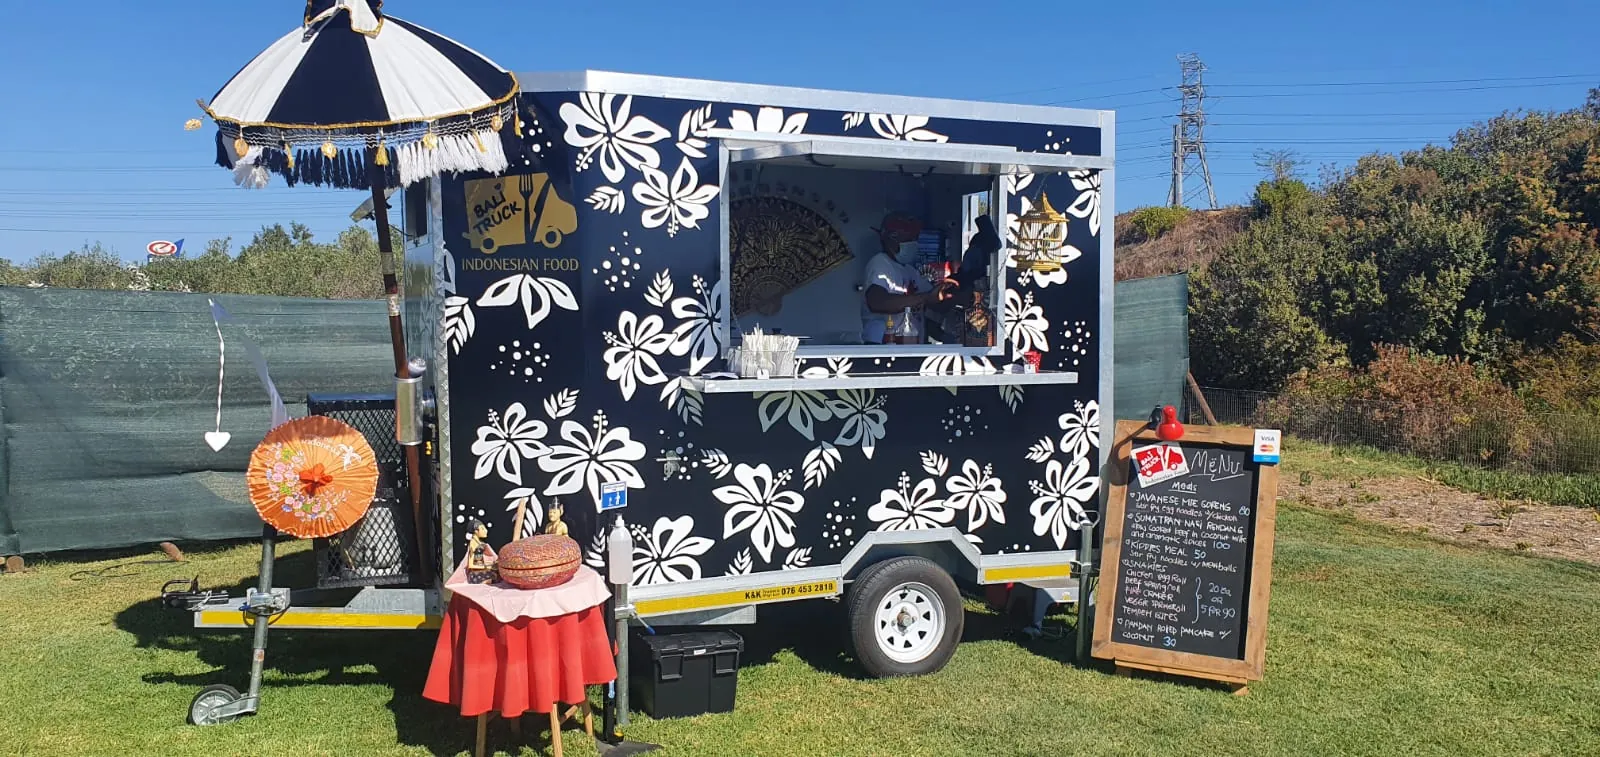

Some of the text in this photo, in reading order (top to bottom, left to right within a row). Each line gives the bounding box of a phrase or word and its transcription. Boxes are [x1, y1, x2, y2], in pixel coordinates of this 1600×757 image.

[473, 201, 522, 236] TRUCK
[462, 258, 579, 271] INDONESIAN FOOD
[1141, 456, 1161, 472] TRUCK
[1136, 492, 1179, 506] JAVANESE
[1182, 497, 1198, 508] MIE
[1239, 505, 1250, 516] 80
[1162, 506, 1174, 515] egg
[1177, 507, 1202, 517] noodles
[1135, 513, 1243, 534] SUMATRAN NASI RENDANG
[1165, 545, 1188, 557] MEAL
[1194, 549, 1206, 560] 50
[1213, 540, 1230, 550] 100
[745, 589, 761, 600] K&K
[781, 586, 796, 595] 076
[798, 584, 812, 593] 453
[1209, 582, 1220, 593] 20
[1211, 596, 1223, 605] OR
[1122, 605, 1152, 618] TEMPEH
[1200, 604, 1208, 614] 5
[1222, 607, 1236, 619] 90
[1124, 620, 1152, 632] PANDAN
[1122, 631, 1176, 647] COCONUT 30
